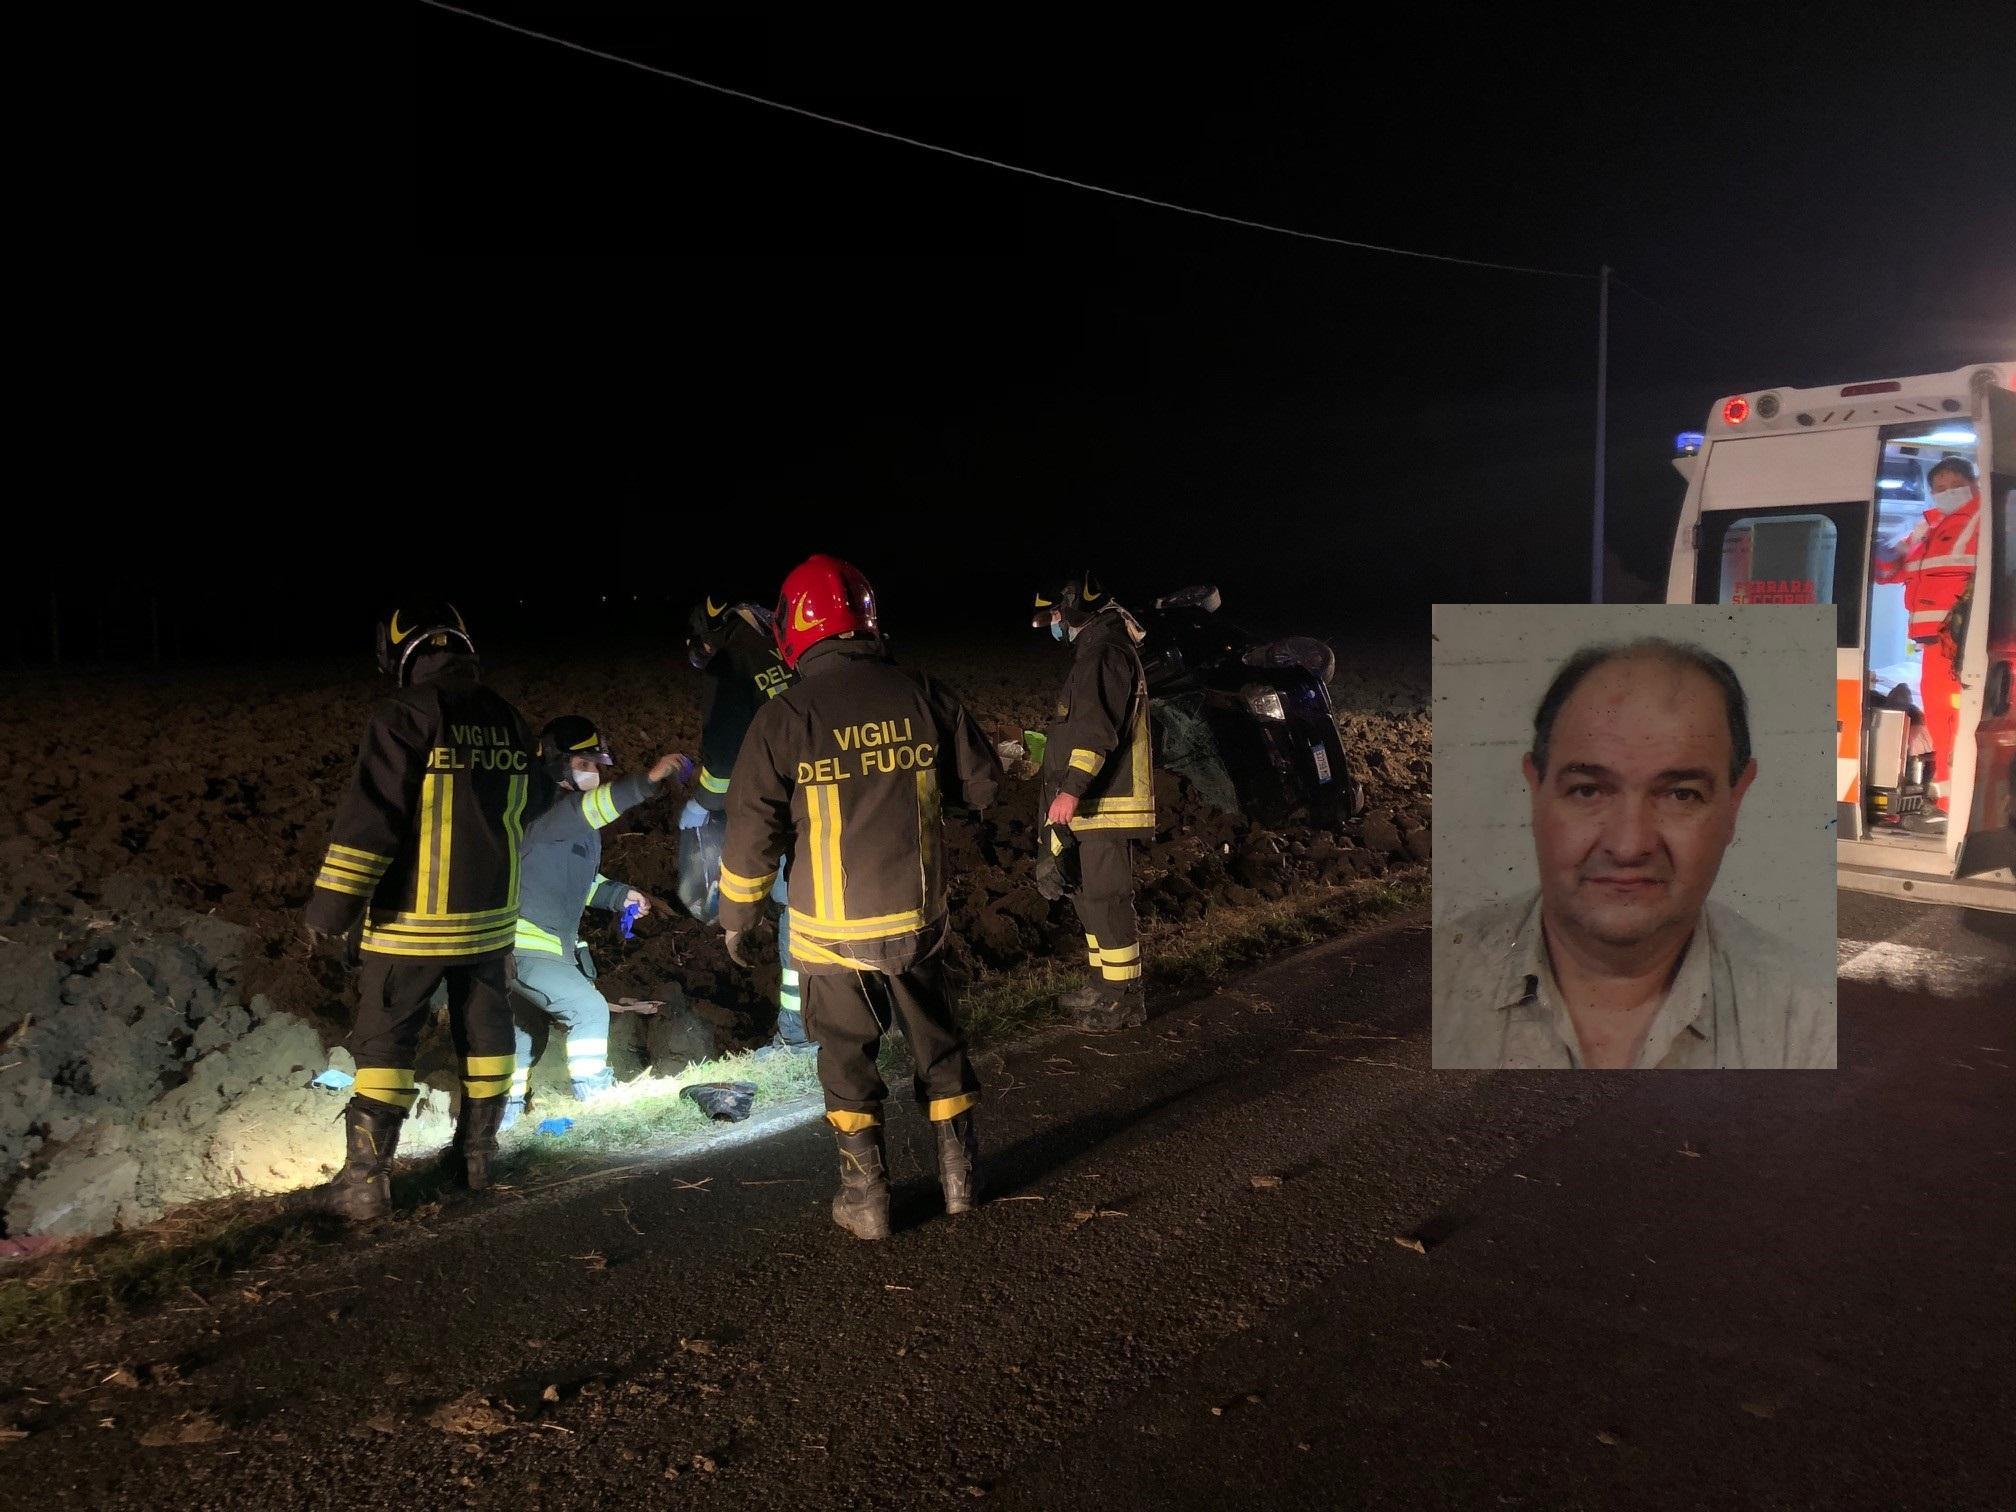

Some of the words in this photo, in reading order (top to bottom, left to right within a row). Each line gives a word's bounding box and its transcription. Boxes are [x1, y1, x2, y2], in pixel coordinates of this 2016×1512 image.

[754, 665, 793, 691] DEL
[450, 724, 511, 747] VIGILI
[832, 717, 913, 752] VIGILI
[470, 748, 528, 771] FUOC
[797, 757, 851, 784] DEL
[860, 743, 939, 776] FUOC
